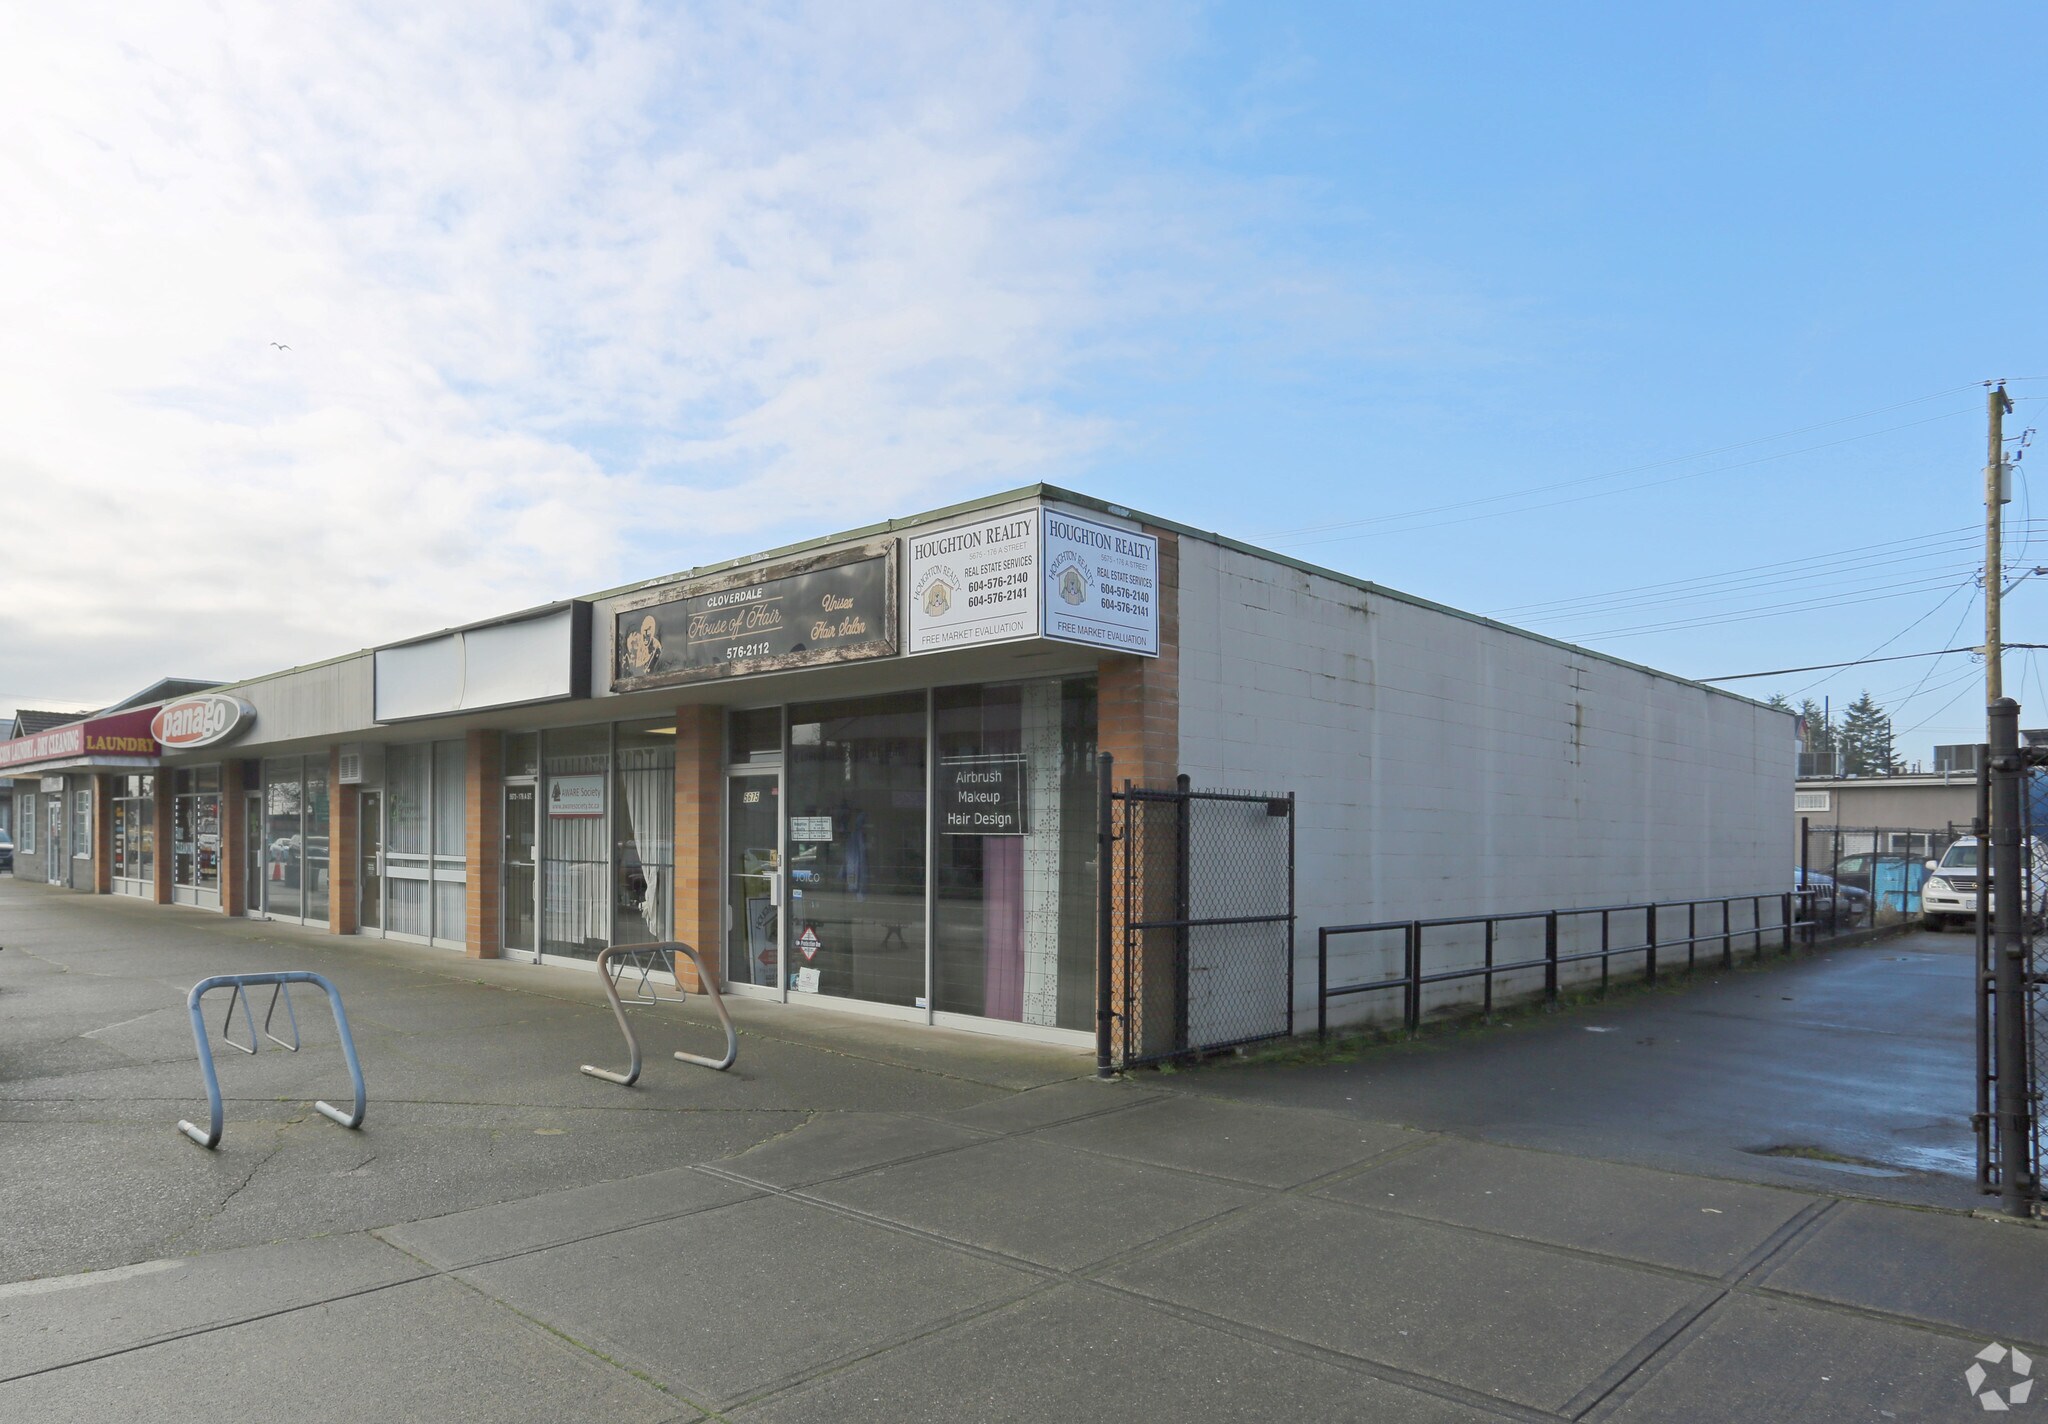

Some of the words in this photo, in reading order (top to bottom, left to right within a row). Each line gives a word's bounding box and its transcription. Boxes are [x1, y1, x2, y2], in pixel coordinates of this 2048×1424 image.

[915, 531, 981, 560] HOUGHTON
[986, 519, 1032, 544] REALTY
[1004, 542, 1027, 552] STREET
[1049, 520, 1111, 550] HOUGHTON
[1115, 537, 1152, 560] REALTY
[965, 567, 979, 578] REAL
[981, 561, 1001, 575] ESTATE
[1003, 555, 1033, 570] SERVICES
[1048, 550, 1077, 580] HOUGHTON
[1077, 553, 1095, 588] REALTY
[1129, 560, 1148, 571] STREET
[914, 565, 943, 601] HOUGHTON
[943, 565, 962, 592] REALTY
[968, 572, 1028, 592] 604-576-2140
[1097, 567, 1110, 579] REAL
[1111, 570, 1128, 584] ESTATE
[1129, 574, 1153, 589] SERVICES
[707, 588, 763, 607] CLOVERDALE
[821, 594, 854, 612] Unisex
[968, 587, 1027, 607] 604-576-2141
[1100, 583, 1149, 603] 604-576-2140
[1101, 598, 1149, 617] 604-576-2141
[688, 615, 727, 638] House
[728, 609, 745, 640] of
[746, 604, 782, 628] Hair
[811, 621, 836, 640] Hair
[838, 616, 866, 637] Salon
[921, 634, 940, 645] FREE
[941, 628, 973, 643] MARKET
[975, 621, 1024, 636] EVALUATION
[1057, 621, 1076, 634] FREE
[1077, 625, 1106, 639] MARKET
[1107, 631, 1147, 646] EVALUATION
[162, 699, 226, 744] panago
[86, 735, 155, 752] LAUNDRY
[956, 771, 1002, 783] Airbrush
[561, 787, 579, 797] AWARE
[581, 787, 601, 798] Society
[743, 791, 760, 803] 5675
[958, 791, 1000, 805] Makeup
[947, 812, 971, 824] Hair
[974, 812, 1012, 827] Design
[795, 873, 820, 882] JOICO
